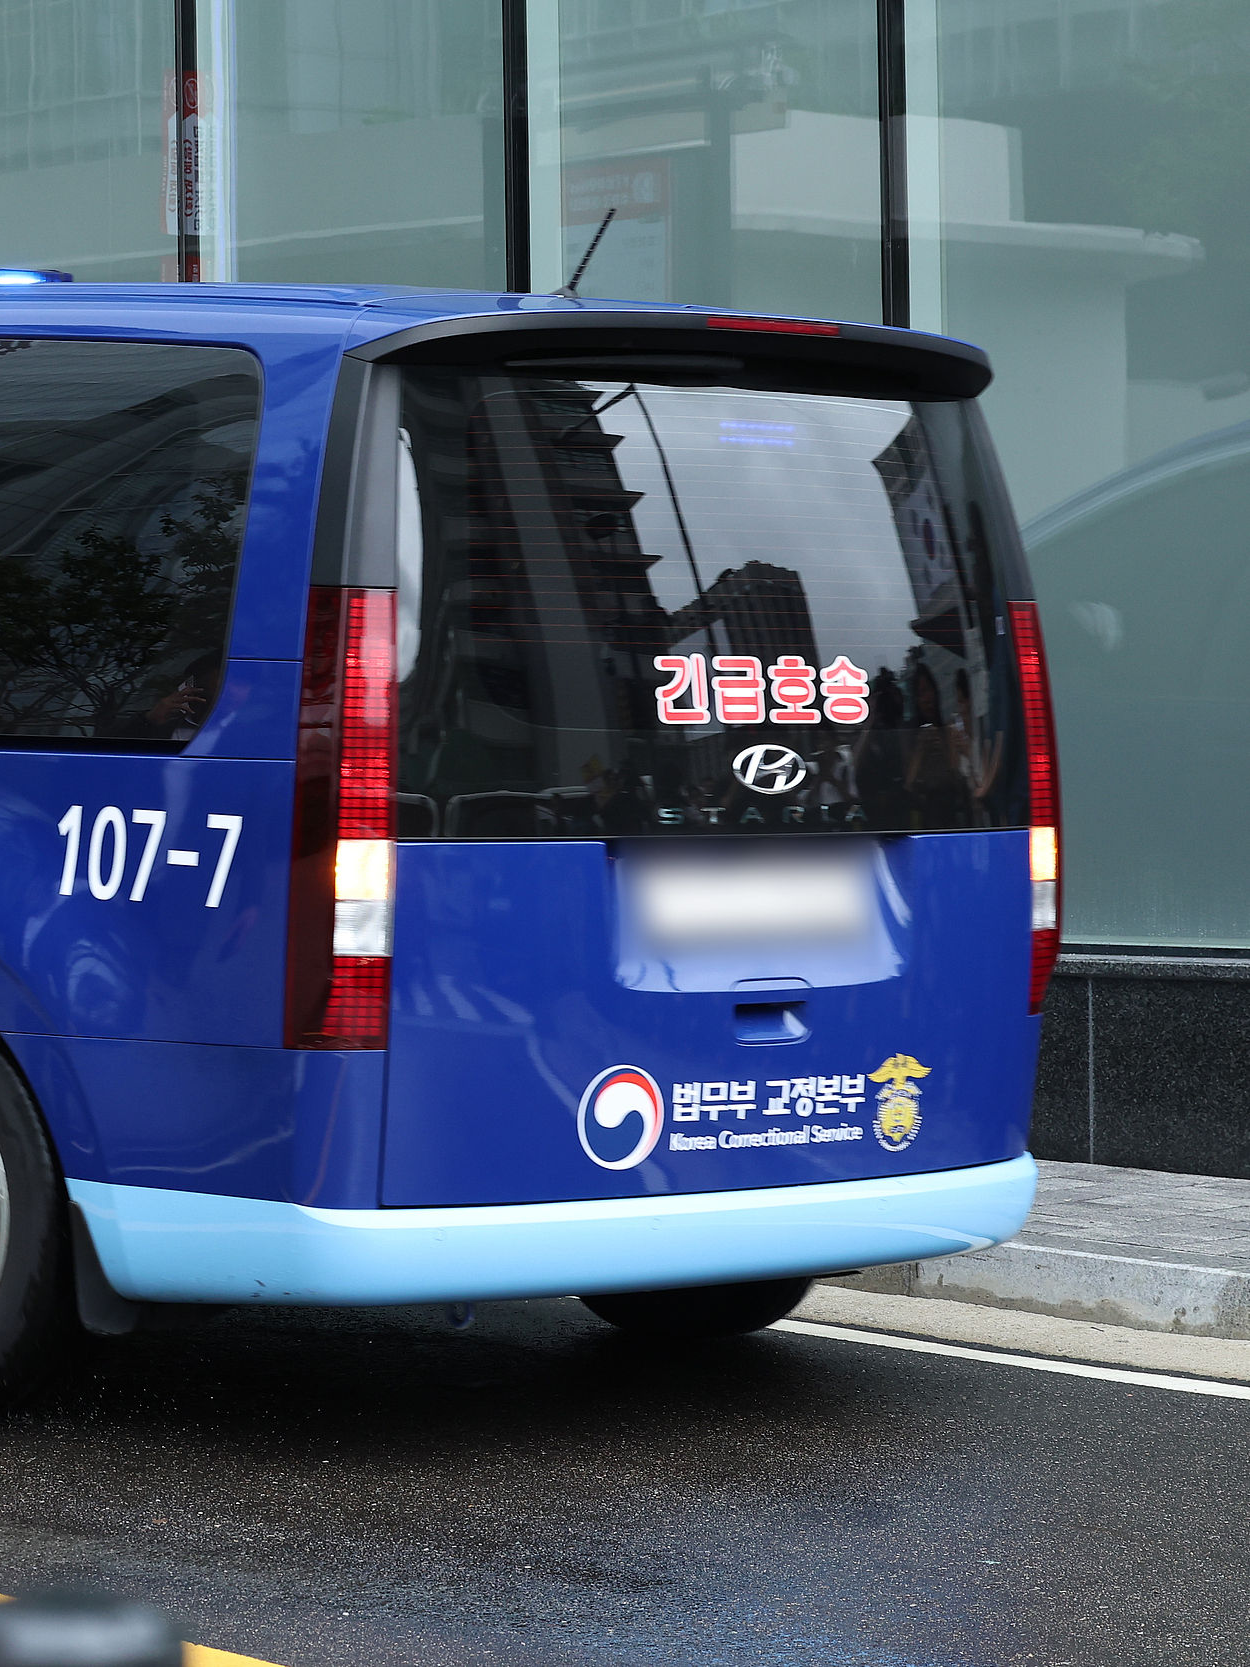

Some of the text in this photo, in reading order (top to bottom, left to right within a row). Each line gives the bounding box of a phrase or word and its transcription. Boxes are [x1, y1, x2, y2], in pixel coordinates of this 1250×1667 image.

[653, 653, 870, 725] 긴급호송
[657, 805, 868, 825] STARIA
[57, 805, 243, 908] 107-7
[672, 1080, 757, 1122] 법무부
[762, 1073, 866, 1117] 교정본부
[668, 1132, 717, 1151] Korea
[718, 1125, 810, 1149] Correctional
[810, 1122, 863, 1143] Service
